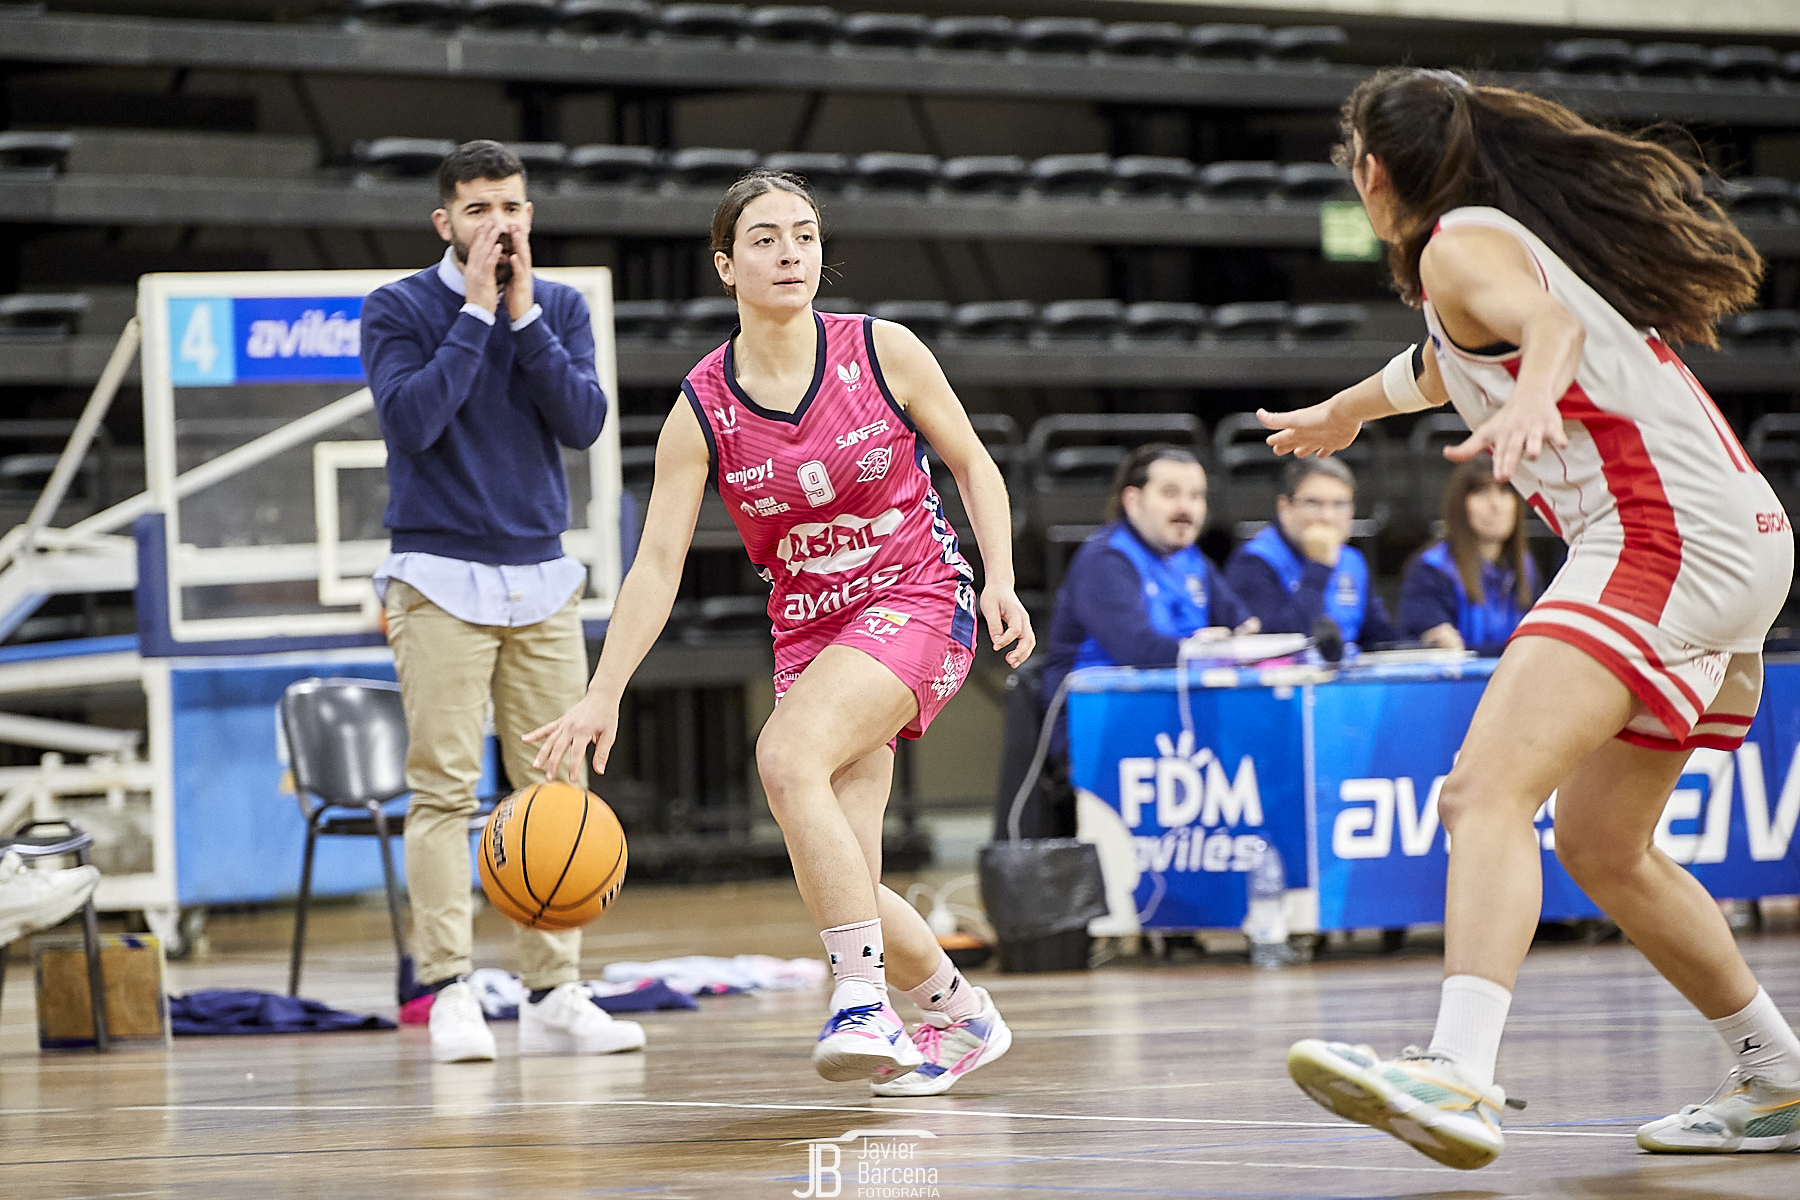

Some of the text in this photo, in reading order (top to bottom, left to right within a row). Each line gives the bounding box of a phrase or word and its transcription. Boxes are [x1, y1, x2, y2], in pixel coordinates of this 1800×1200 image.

[180, 301, 218, 375] 4
[835, 418, 890, 450] SANFER
[725, 457, 774, 486] enjoy!
[797, 460, 836, 508] 9
[1118, 752, 1264, 829] FDM
